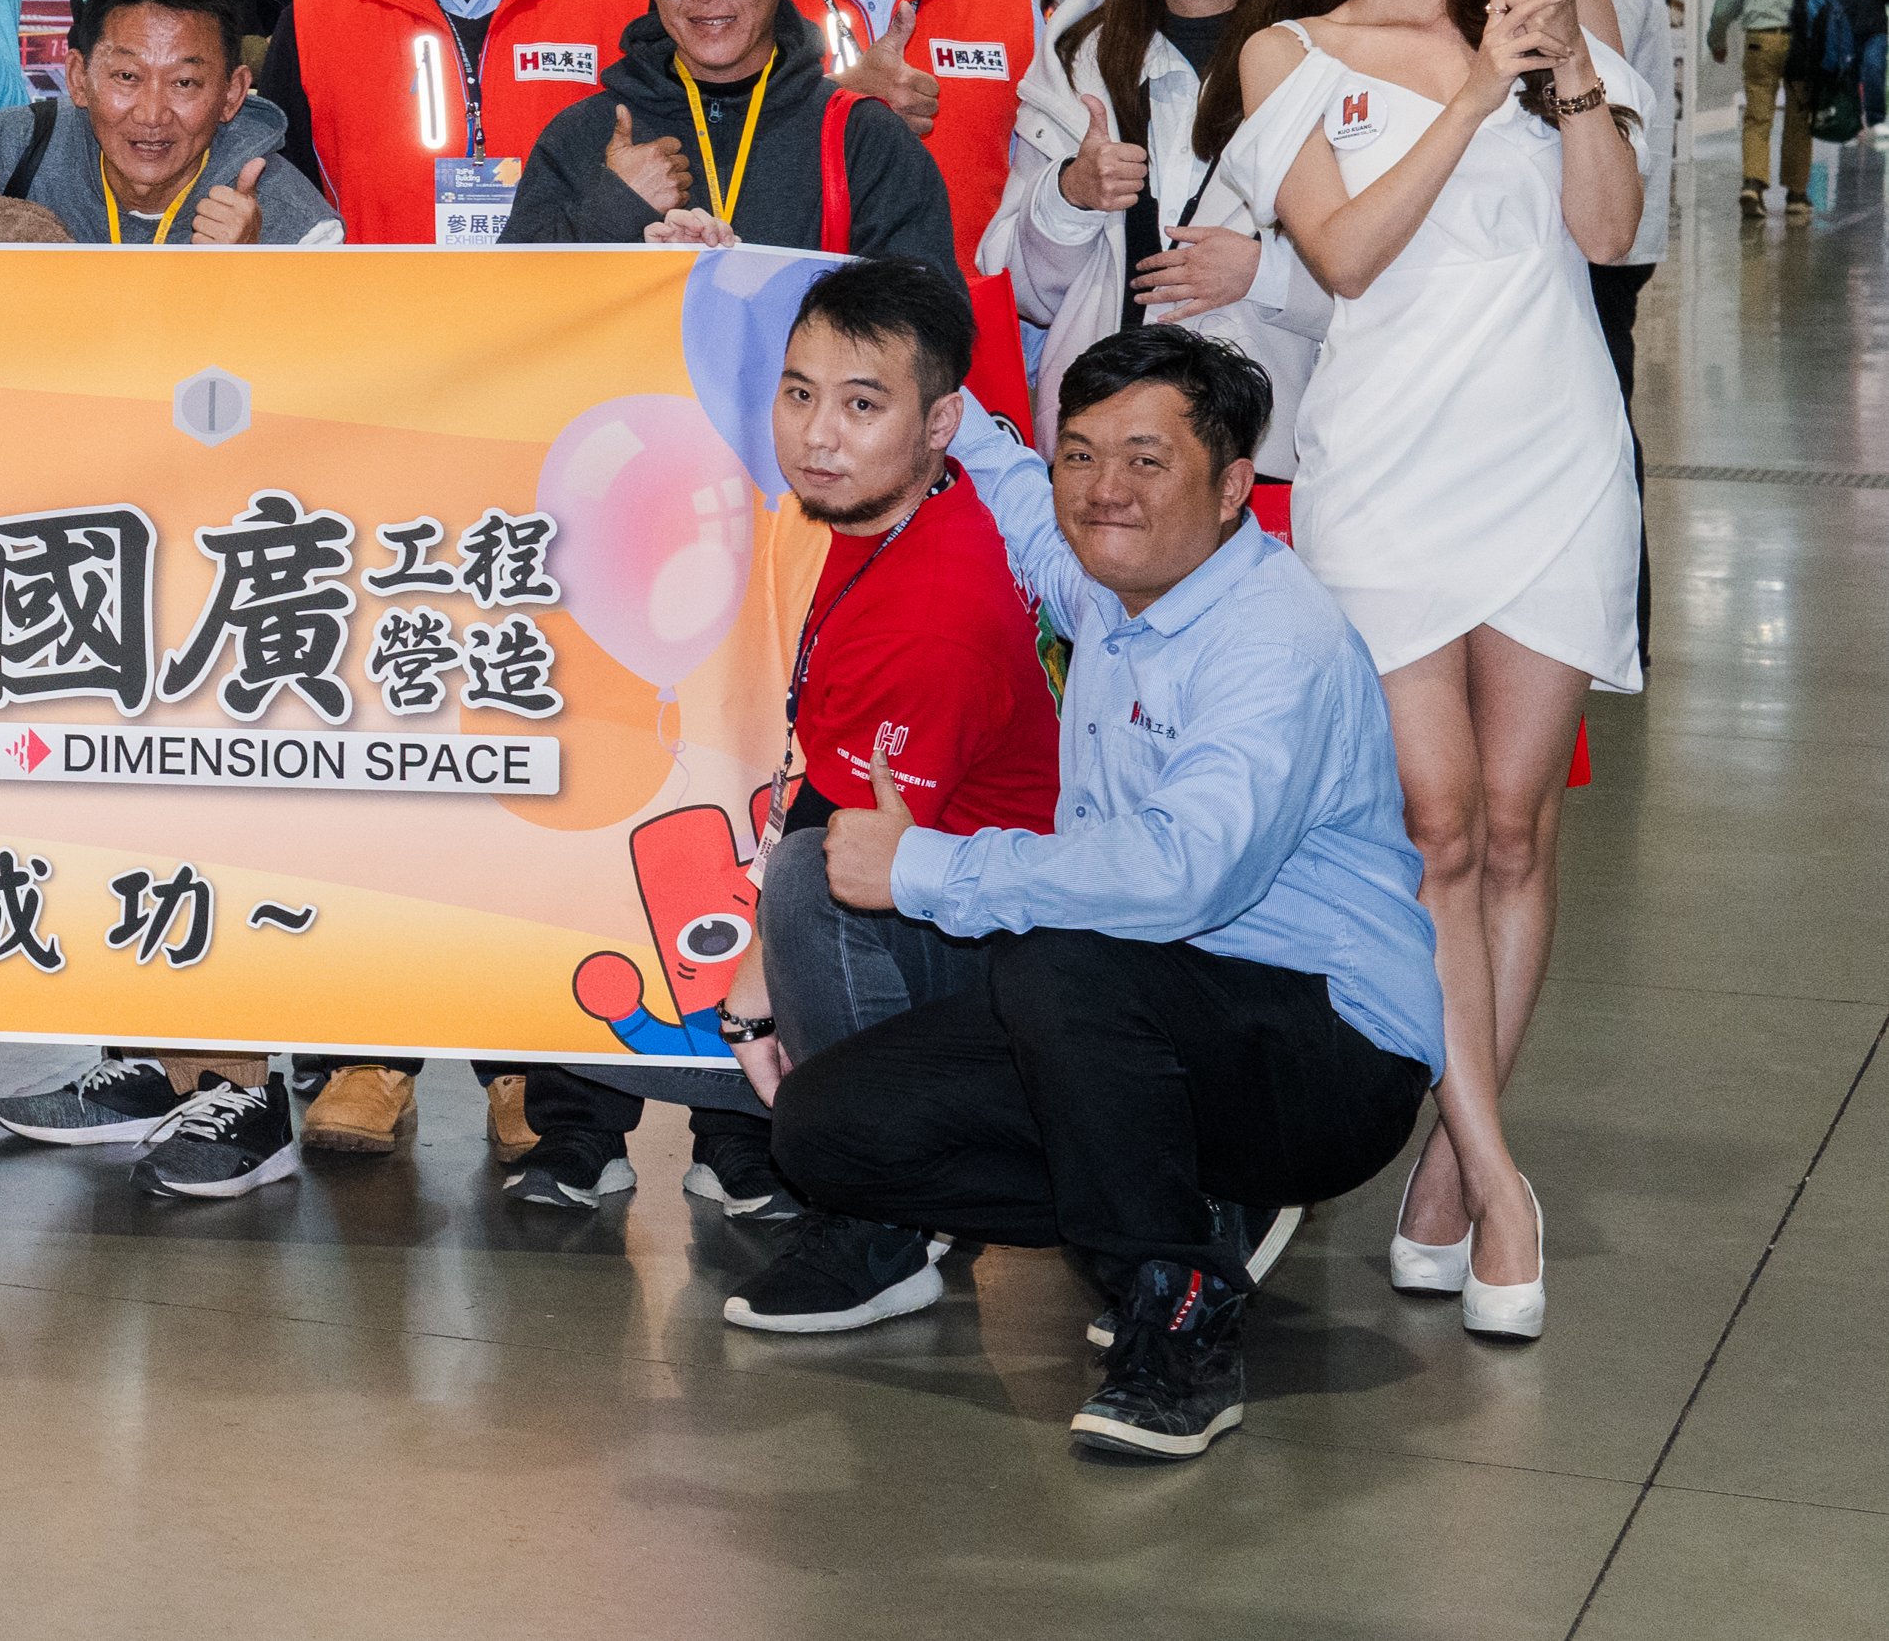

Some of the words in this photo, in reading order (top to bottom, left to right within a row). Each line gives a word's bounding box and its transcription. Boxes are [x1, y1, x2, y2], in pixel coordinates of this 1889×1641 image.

[541, 50, 575, 68] 國廣
[1337, 128, 1351, 136] KUO
[1351, 123, 1373, 133] KUANG
[363, 507, 561, 608] 工程
[365, 605, 564, 717] 營造
[63, 732, 346, 781] DIMENSION
[364, 740, 532, 786] SPACE
[1169, 1290, 1198, 1332] PRADA
